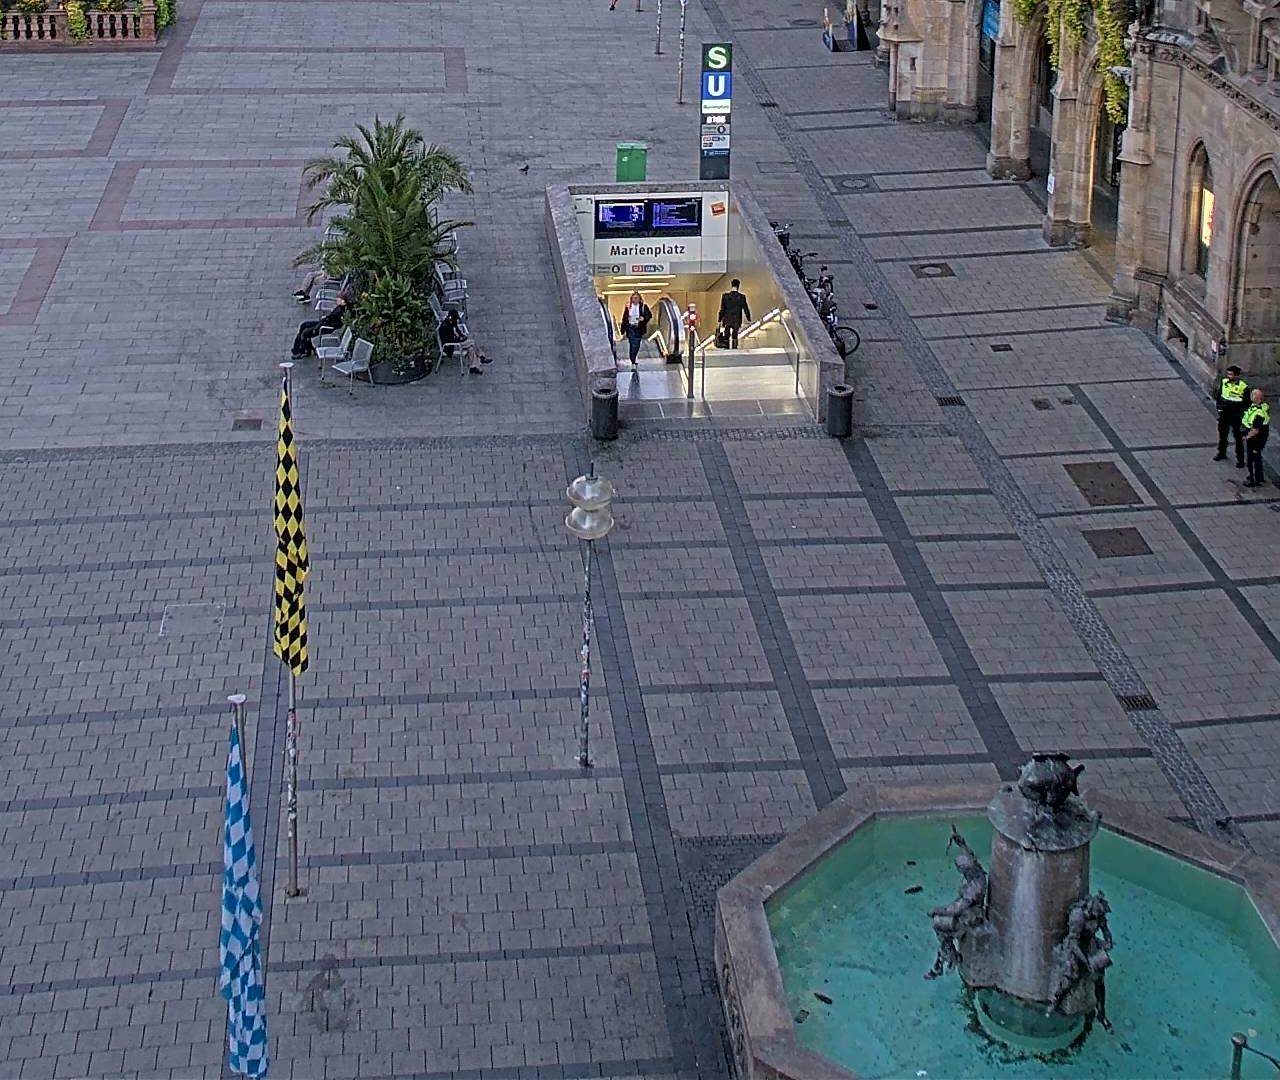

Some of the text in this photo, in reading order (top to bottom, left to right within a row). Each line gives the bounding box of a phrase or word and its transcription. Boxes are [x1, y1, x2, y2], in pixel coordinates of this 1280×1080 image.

[708, 46, 727, 69] S
[707, 75, 726, 97] U
[610, 244, 686, 258] Marienplatz
